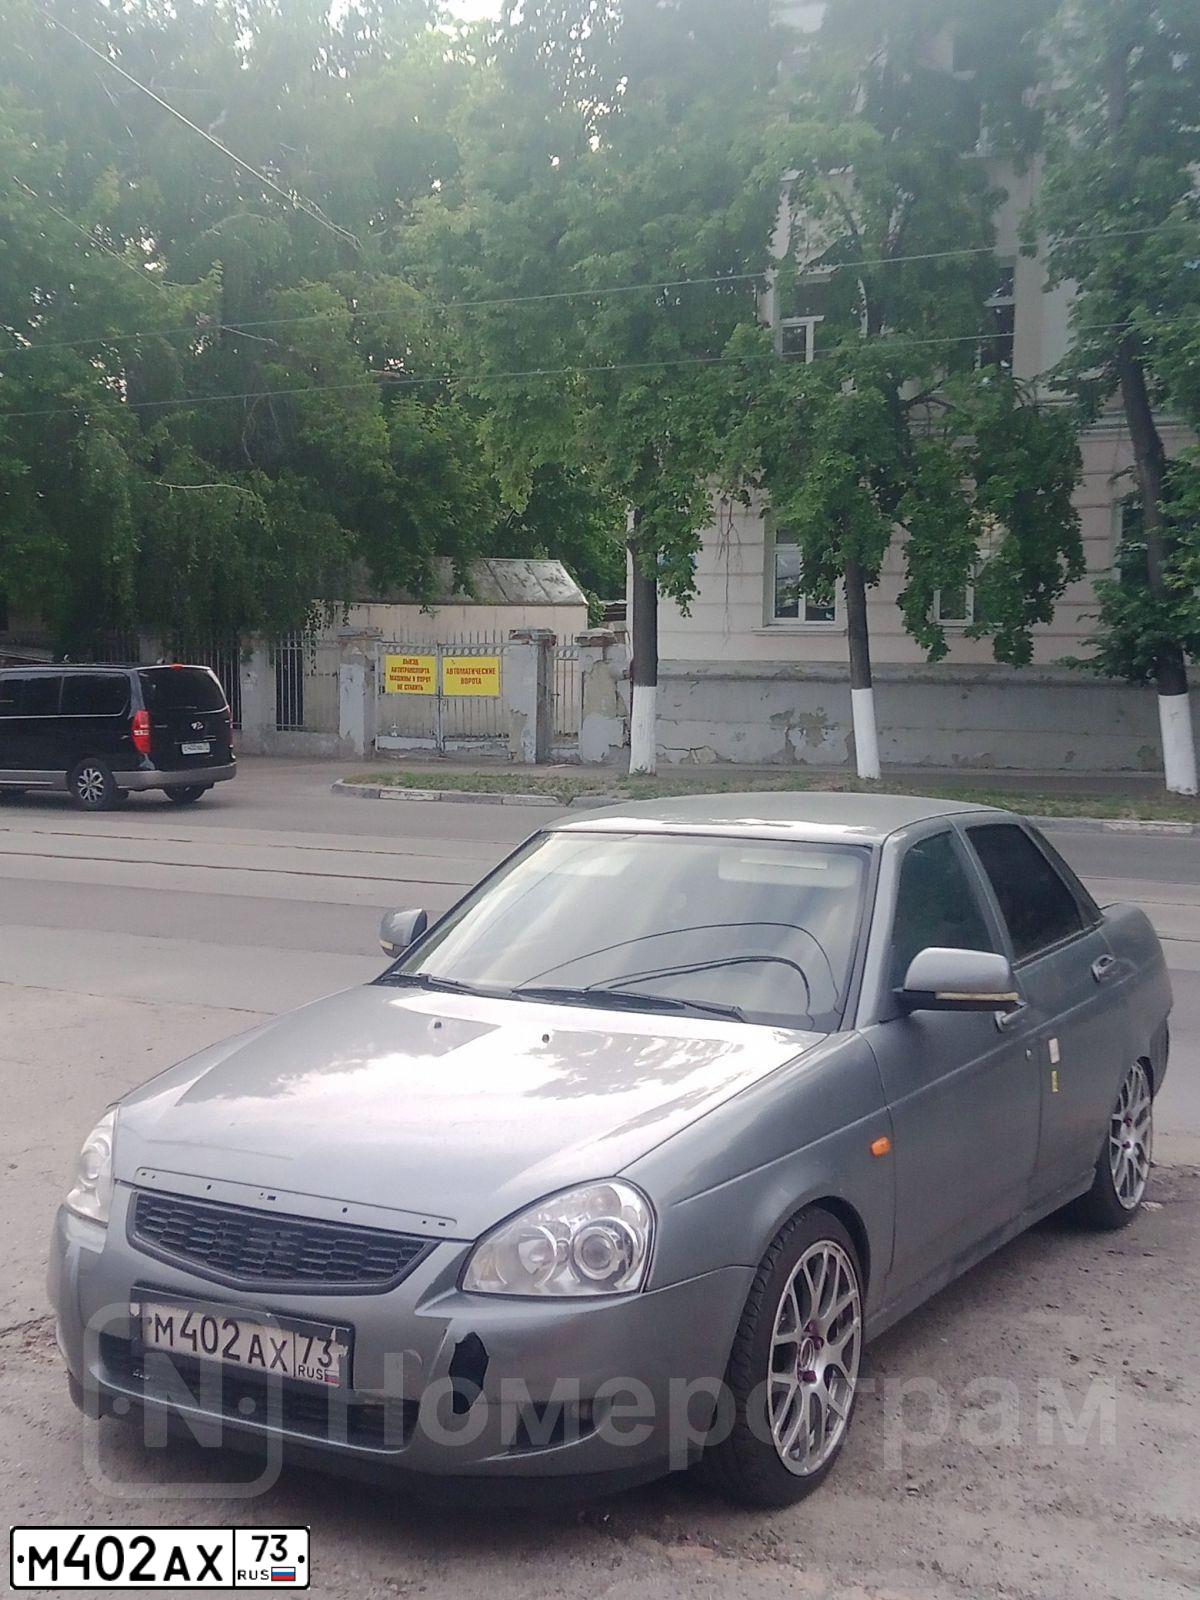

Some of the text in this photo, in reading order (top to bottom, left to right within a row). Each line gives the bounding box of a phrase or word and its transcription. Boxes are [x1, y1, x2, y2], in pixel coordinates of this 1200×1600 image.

[402, 658, 419, 666] ВЫЕЗД
[391, 666, 431, 674] АВТОТРАНСПОРТА
[446, 667, 497, 675] АВТОМАТИЧЕСКИЕ
[389, 674, 411, 682] МАШИНЫ
[416, 675, 432, 683] ВОРОТ
[460, 677, 482, 685] ВОРОТА
[404, 683, 424, 691] СТАВИТЬ
[154, 1310, 333, 1372] М402АХ 73
[298, 1365, 323, 1380] RUS
